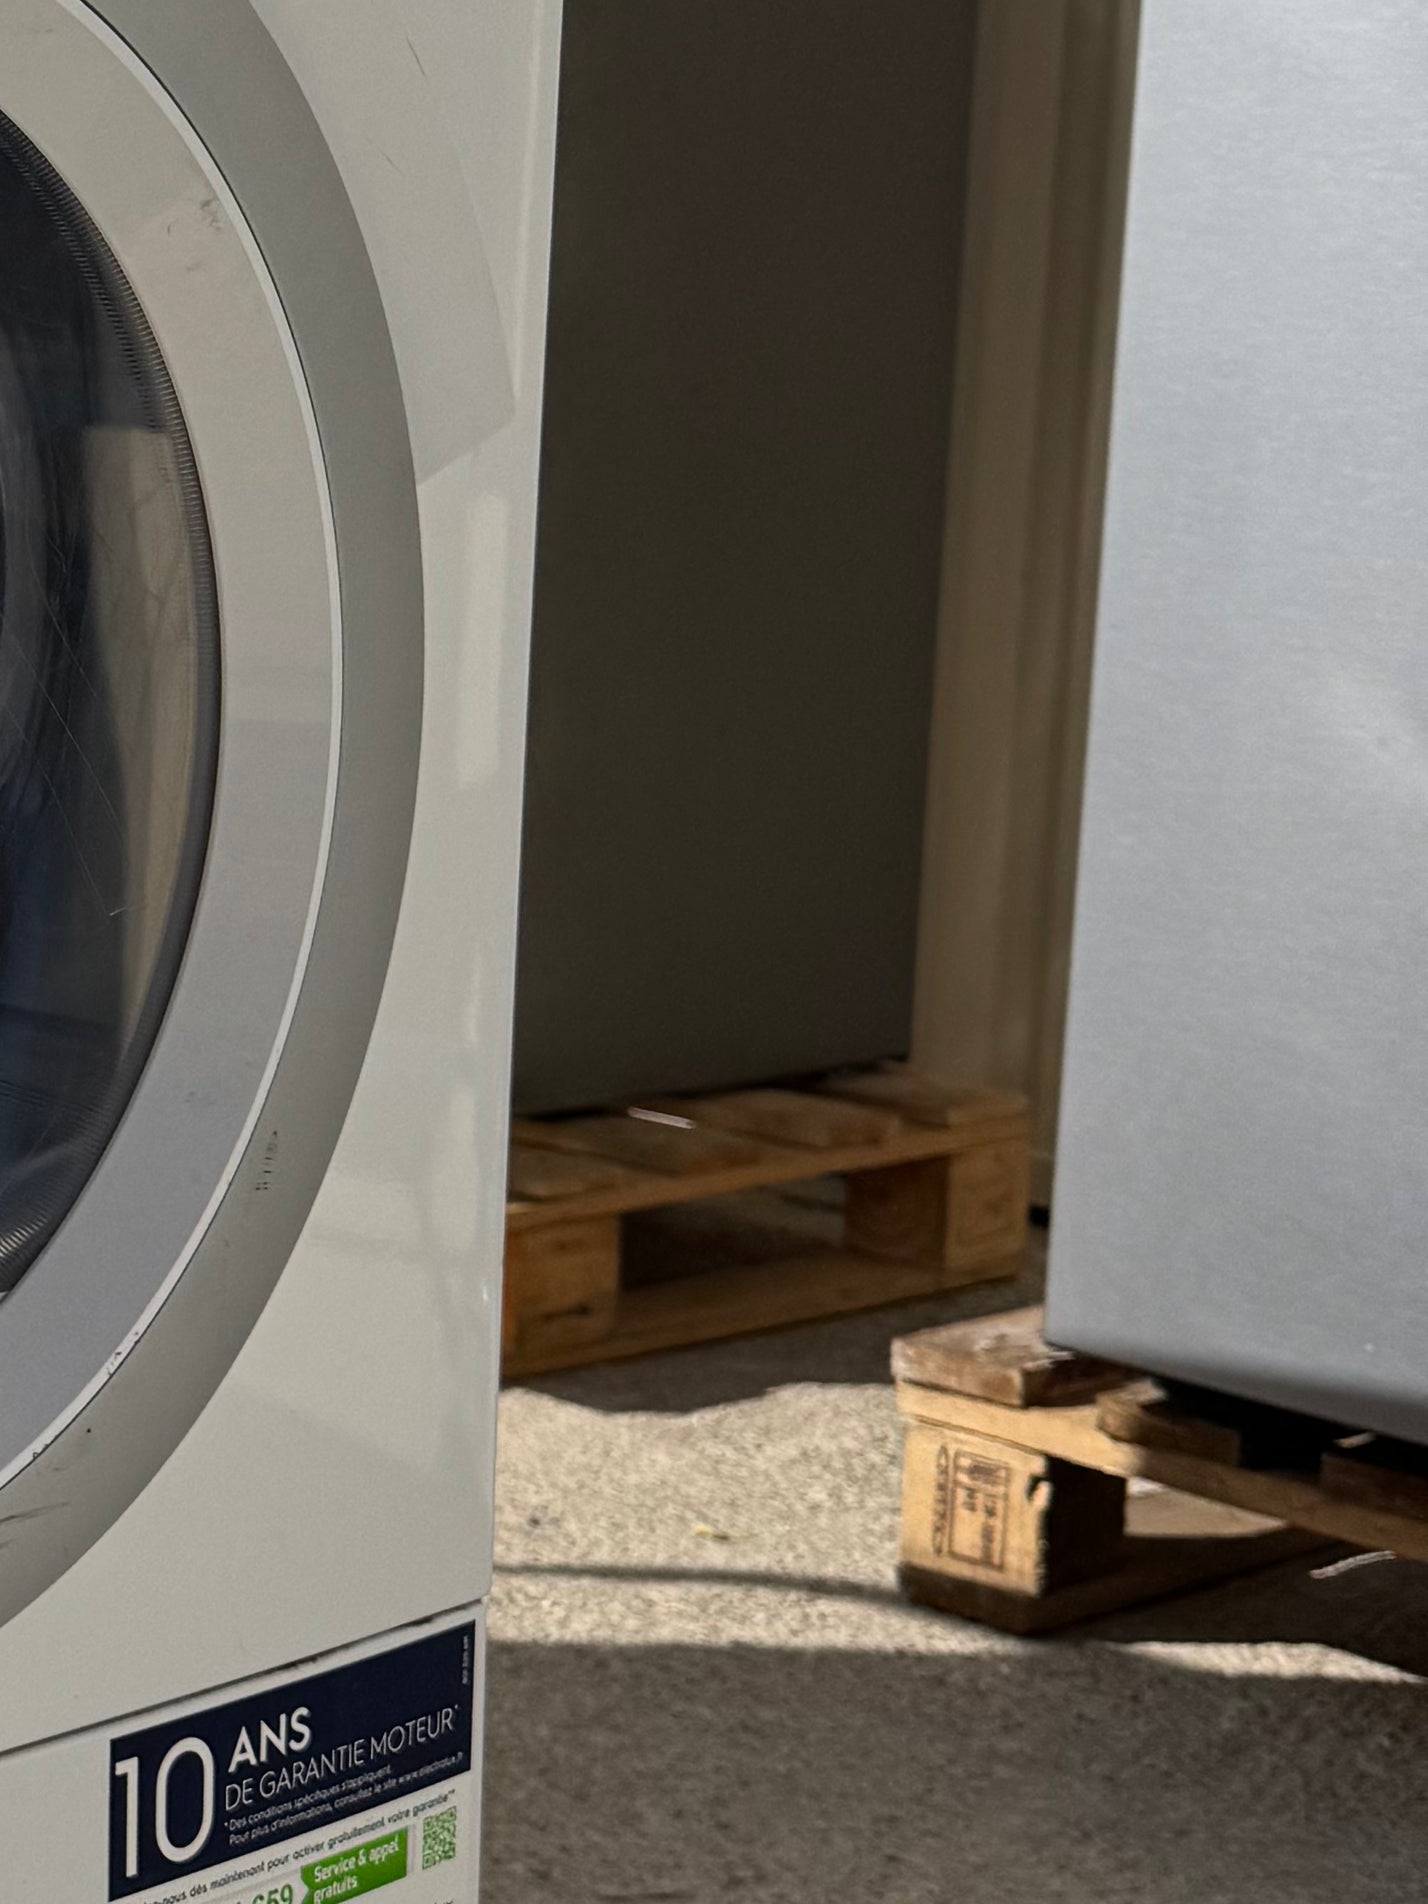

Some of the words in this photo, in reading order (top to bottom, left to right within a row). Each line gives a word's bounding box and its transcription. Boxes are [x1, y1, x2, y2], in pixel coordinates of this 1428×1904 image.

[228, 1706, 311, 1773] ANS
[115, 1736, 215, 1878] 10
[225, 1777, 253, 1811] DE
[259, 1738, 365, 1799] GARANTIE
[209, 1860, 265, 1890] maintenant
[267, 1854, 290, 1872] pour
[314, 1856, 356, 1883] Service
[357, 1848, 367, 1866] &
[368, 1834, 400, 1864] appel
